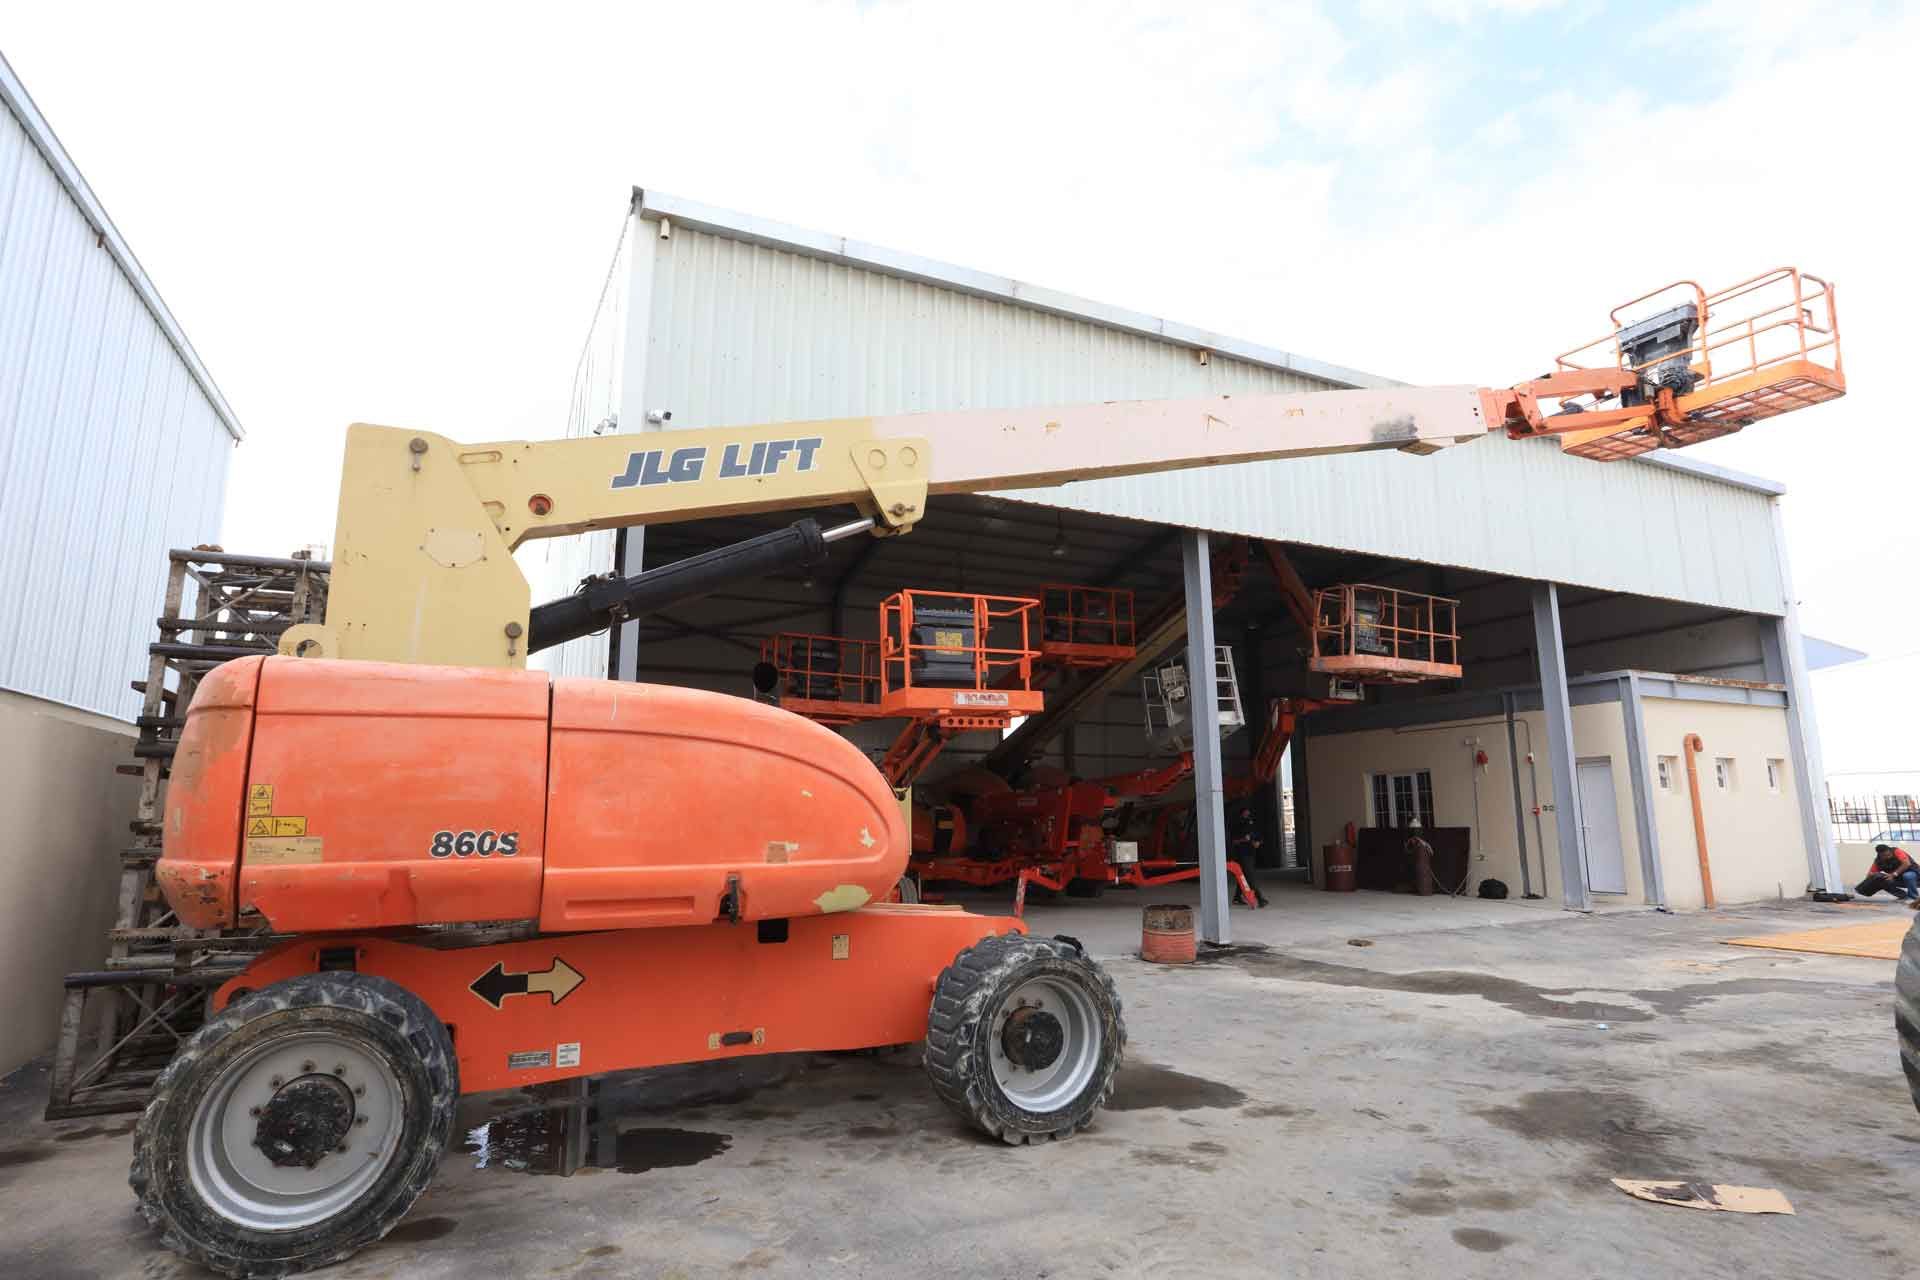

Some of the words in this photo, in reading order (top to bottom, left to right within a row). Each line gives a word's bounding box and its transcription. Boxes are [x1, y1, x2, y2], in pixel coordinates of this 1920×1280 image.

[610, 447, 707, 489] JLG
[718, 437, 822, 479] LIFT
[429, 830, 520, 858] 860S
